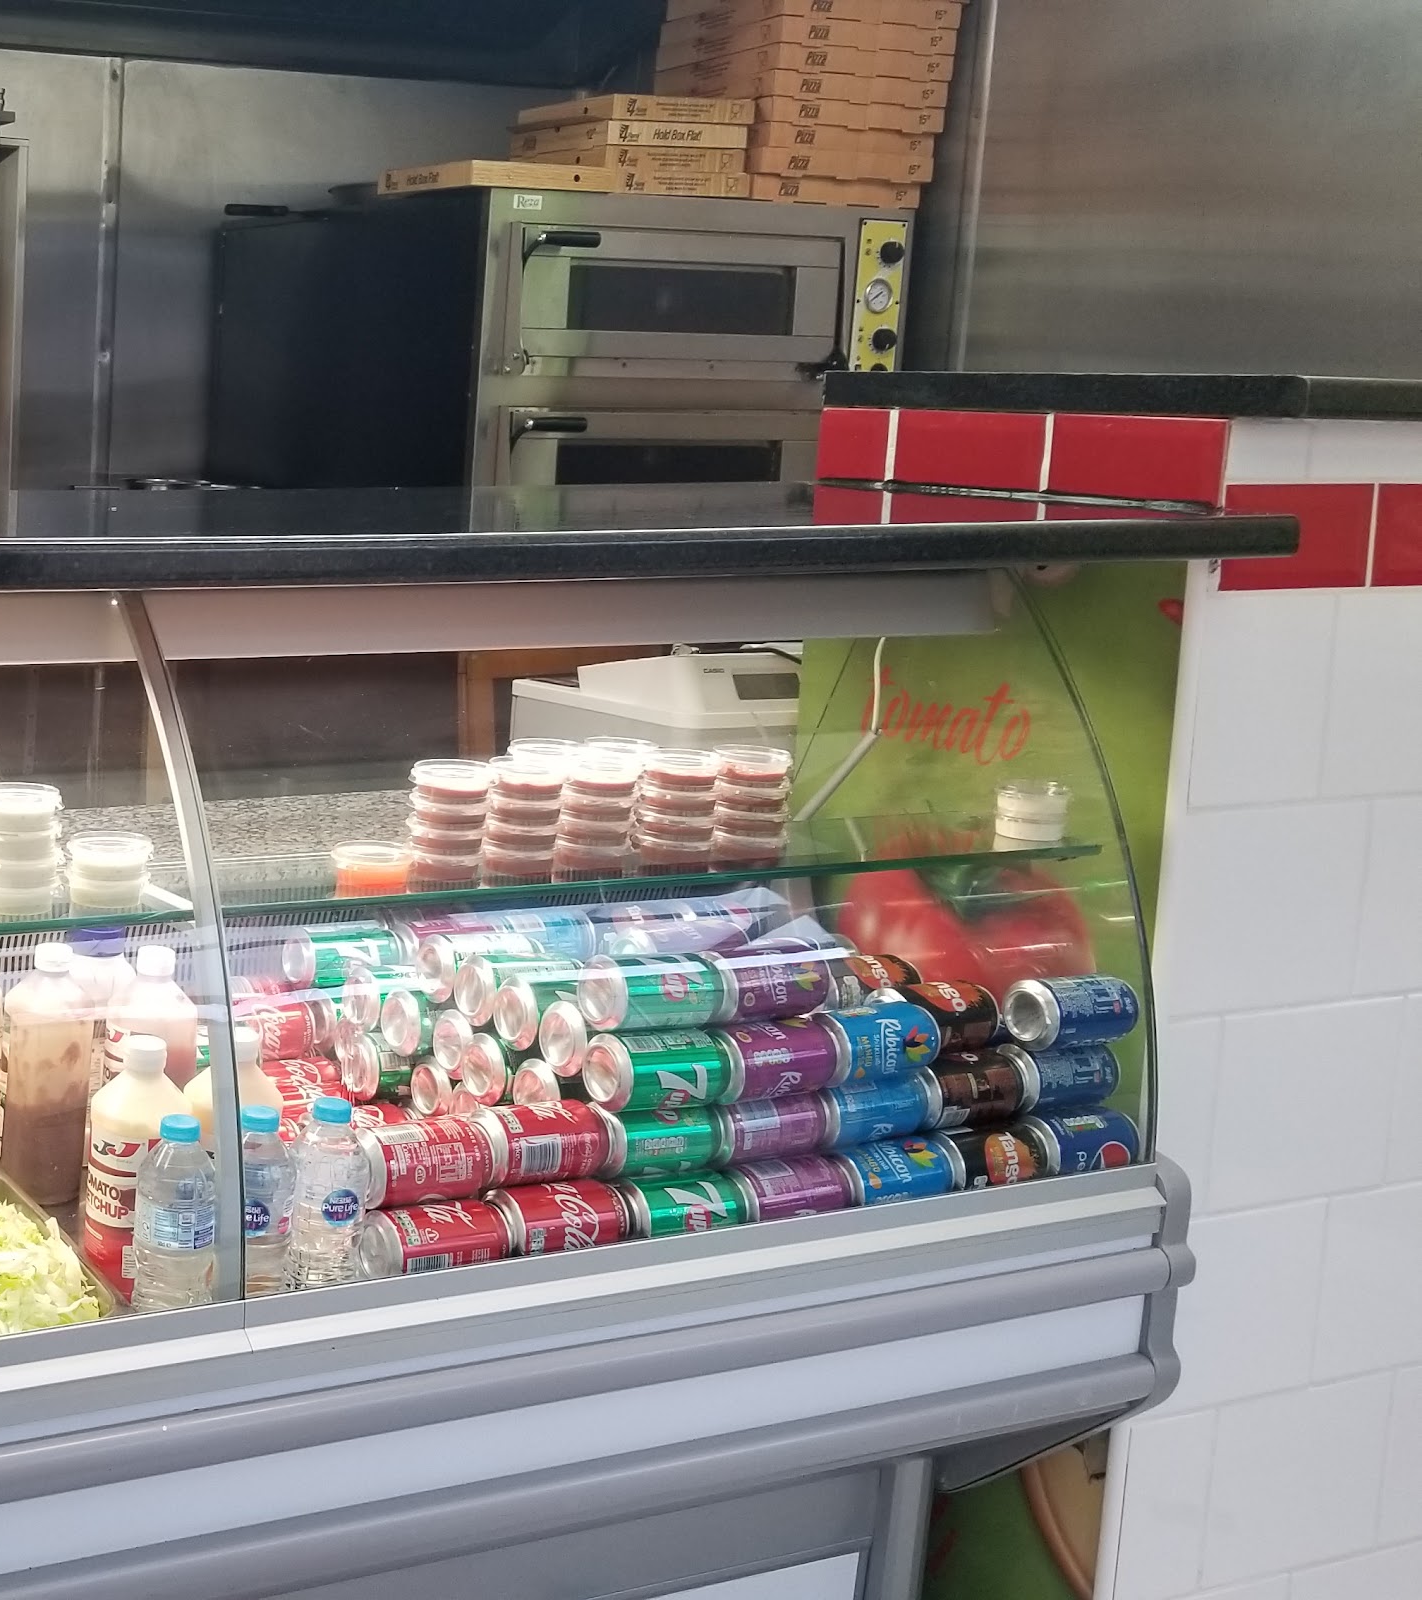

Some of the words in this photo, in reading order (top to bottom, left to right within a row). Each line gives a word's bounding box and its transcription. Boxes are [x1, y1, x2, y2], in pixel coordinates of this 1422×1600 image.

[653, 129, 670, 140] Hold
[671, 130, 685, 140] Box
[516, 194, 540, 208] Reza
[861, 666, 1031, 765] tomato
[87, 1193, 129, 1220] ETCHUP
[322, 1203, 344, 1212] Pure
[344, 1202, 359, 1214] Life
[253, 1213, 270, 1225] Life
